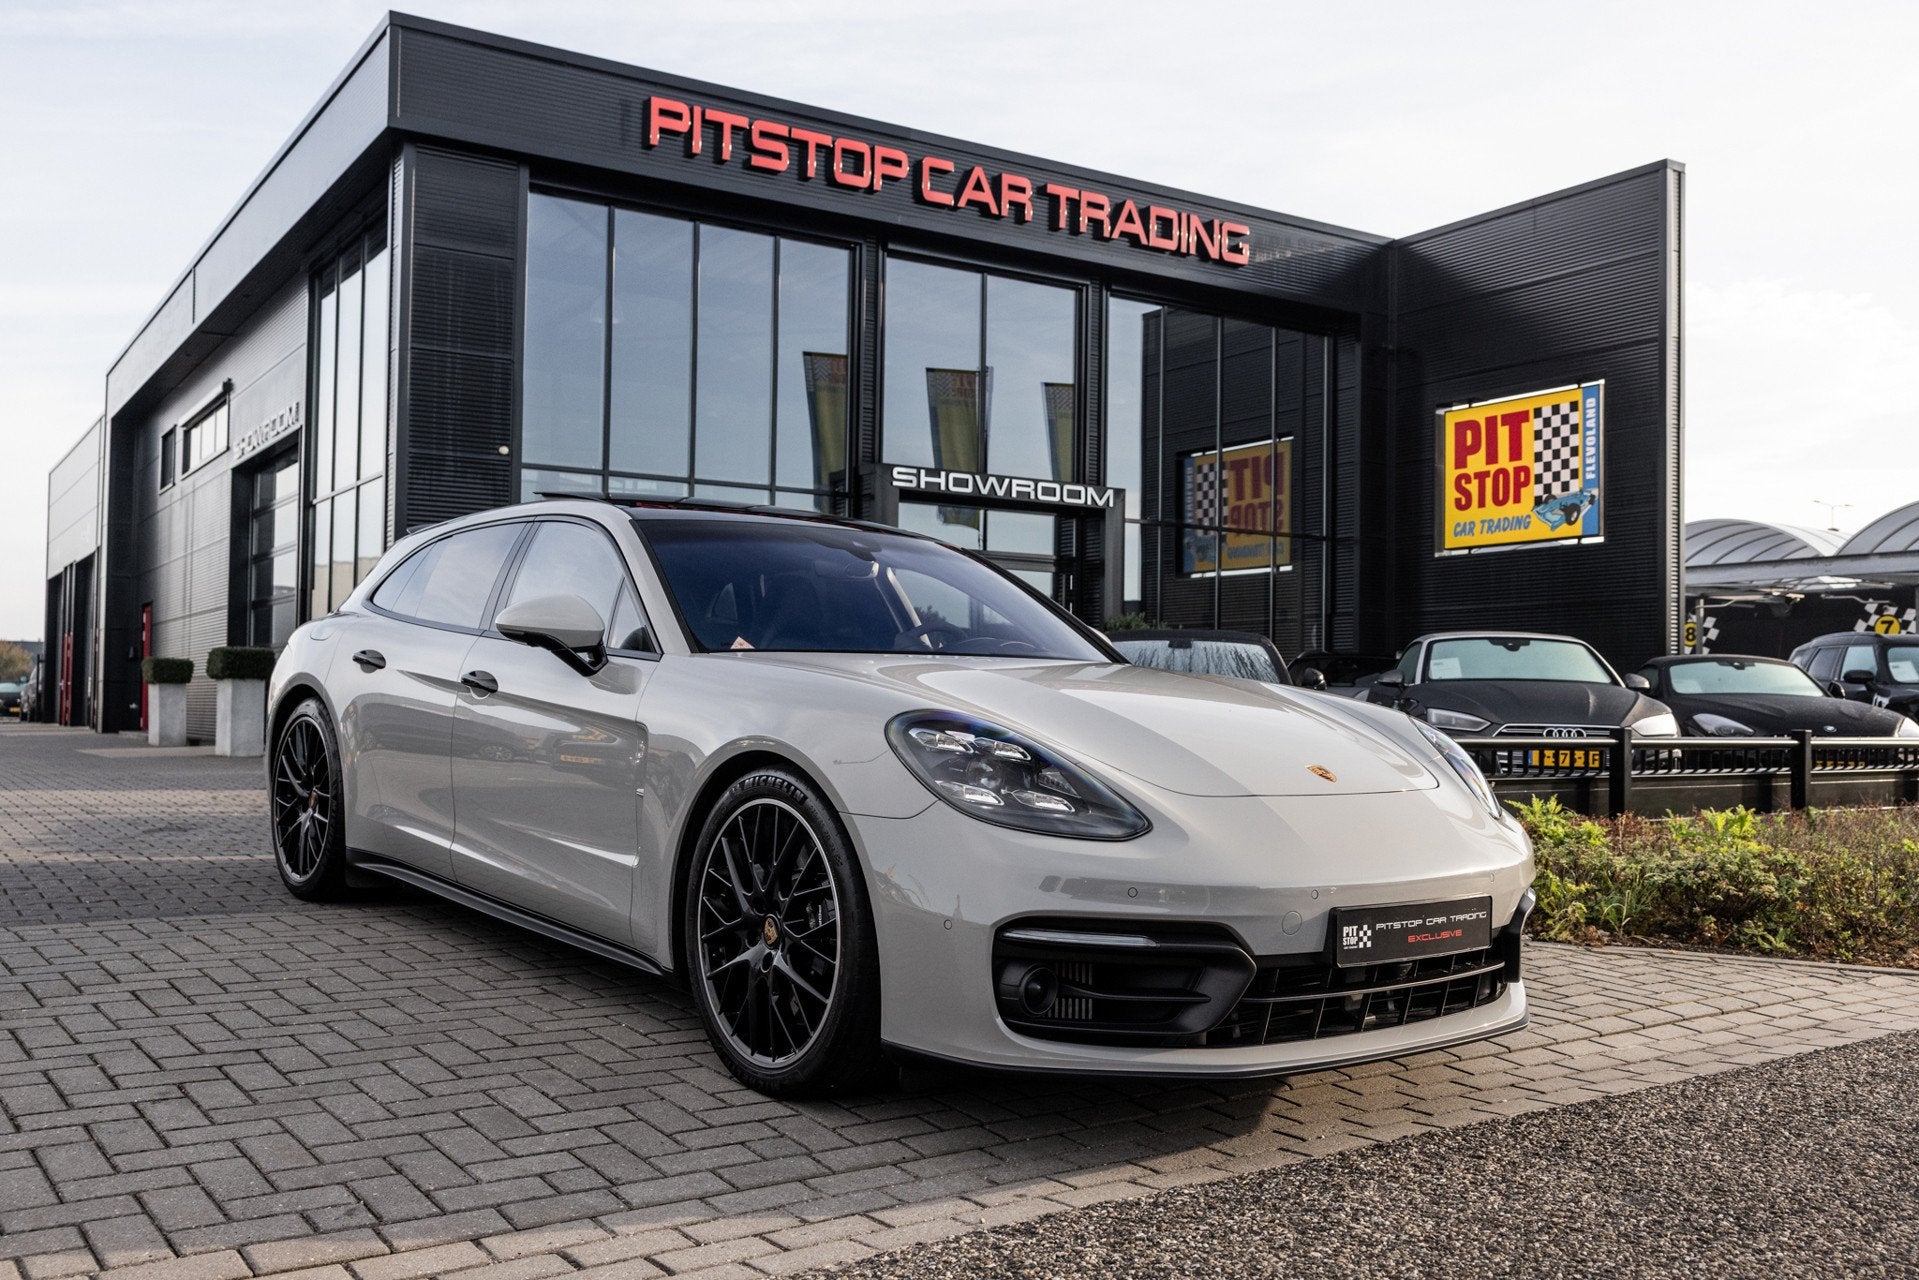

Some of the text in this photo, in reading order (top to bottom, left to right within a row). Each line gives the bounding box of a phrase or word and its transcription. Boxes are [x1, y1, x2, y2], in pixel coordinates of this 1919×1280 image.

[649, 96, 1250, 266] PITSTOP CAR TRADING
[1454, 409, 1530, 470] PIT
[1585, 397, 1597, 480] FLEVOLAND
[892, 466, 1114, 508] SHOWROOM
[1454, 465, 1531, 511] STOP
[1453, 514, 1532, 537] CAR TRADING
[1686, 626, 1696, 642] 8
[1880, 619, 1894, 634] 7
[744, 775, 806, 802] MICHELIN
[1342, 925, 1358, 937] PIT
[1375, 911, 1486, 931] PITSTOP CAR TRADING
[1342, 936, 1358, 946] STOP
[1407, 929, 1462, 943] EXCLUSIVE
